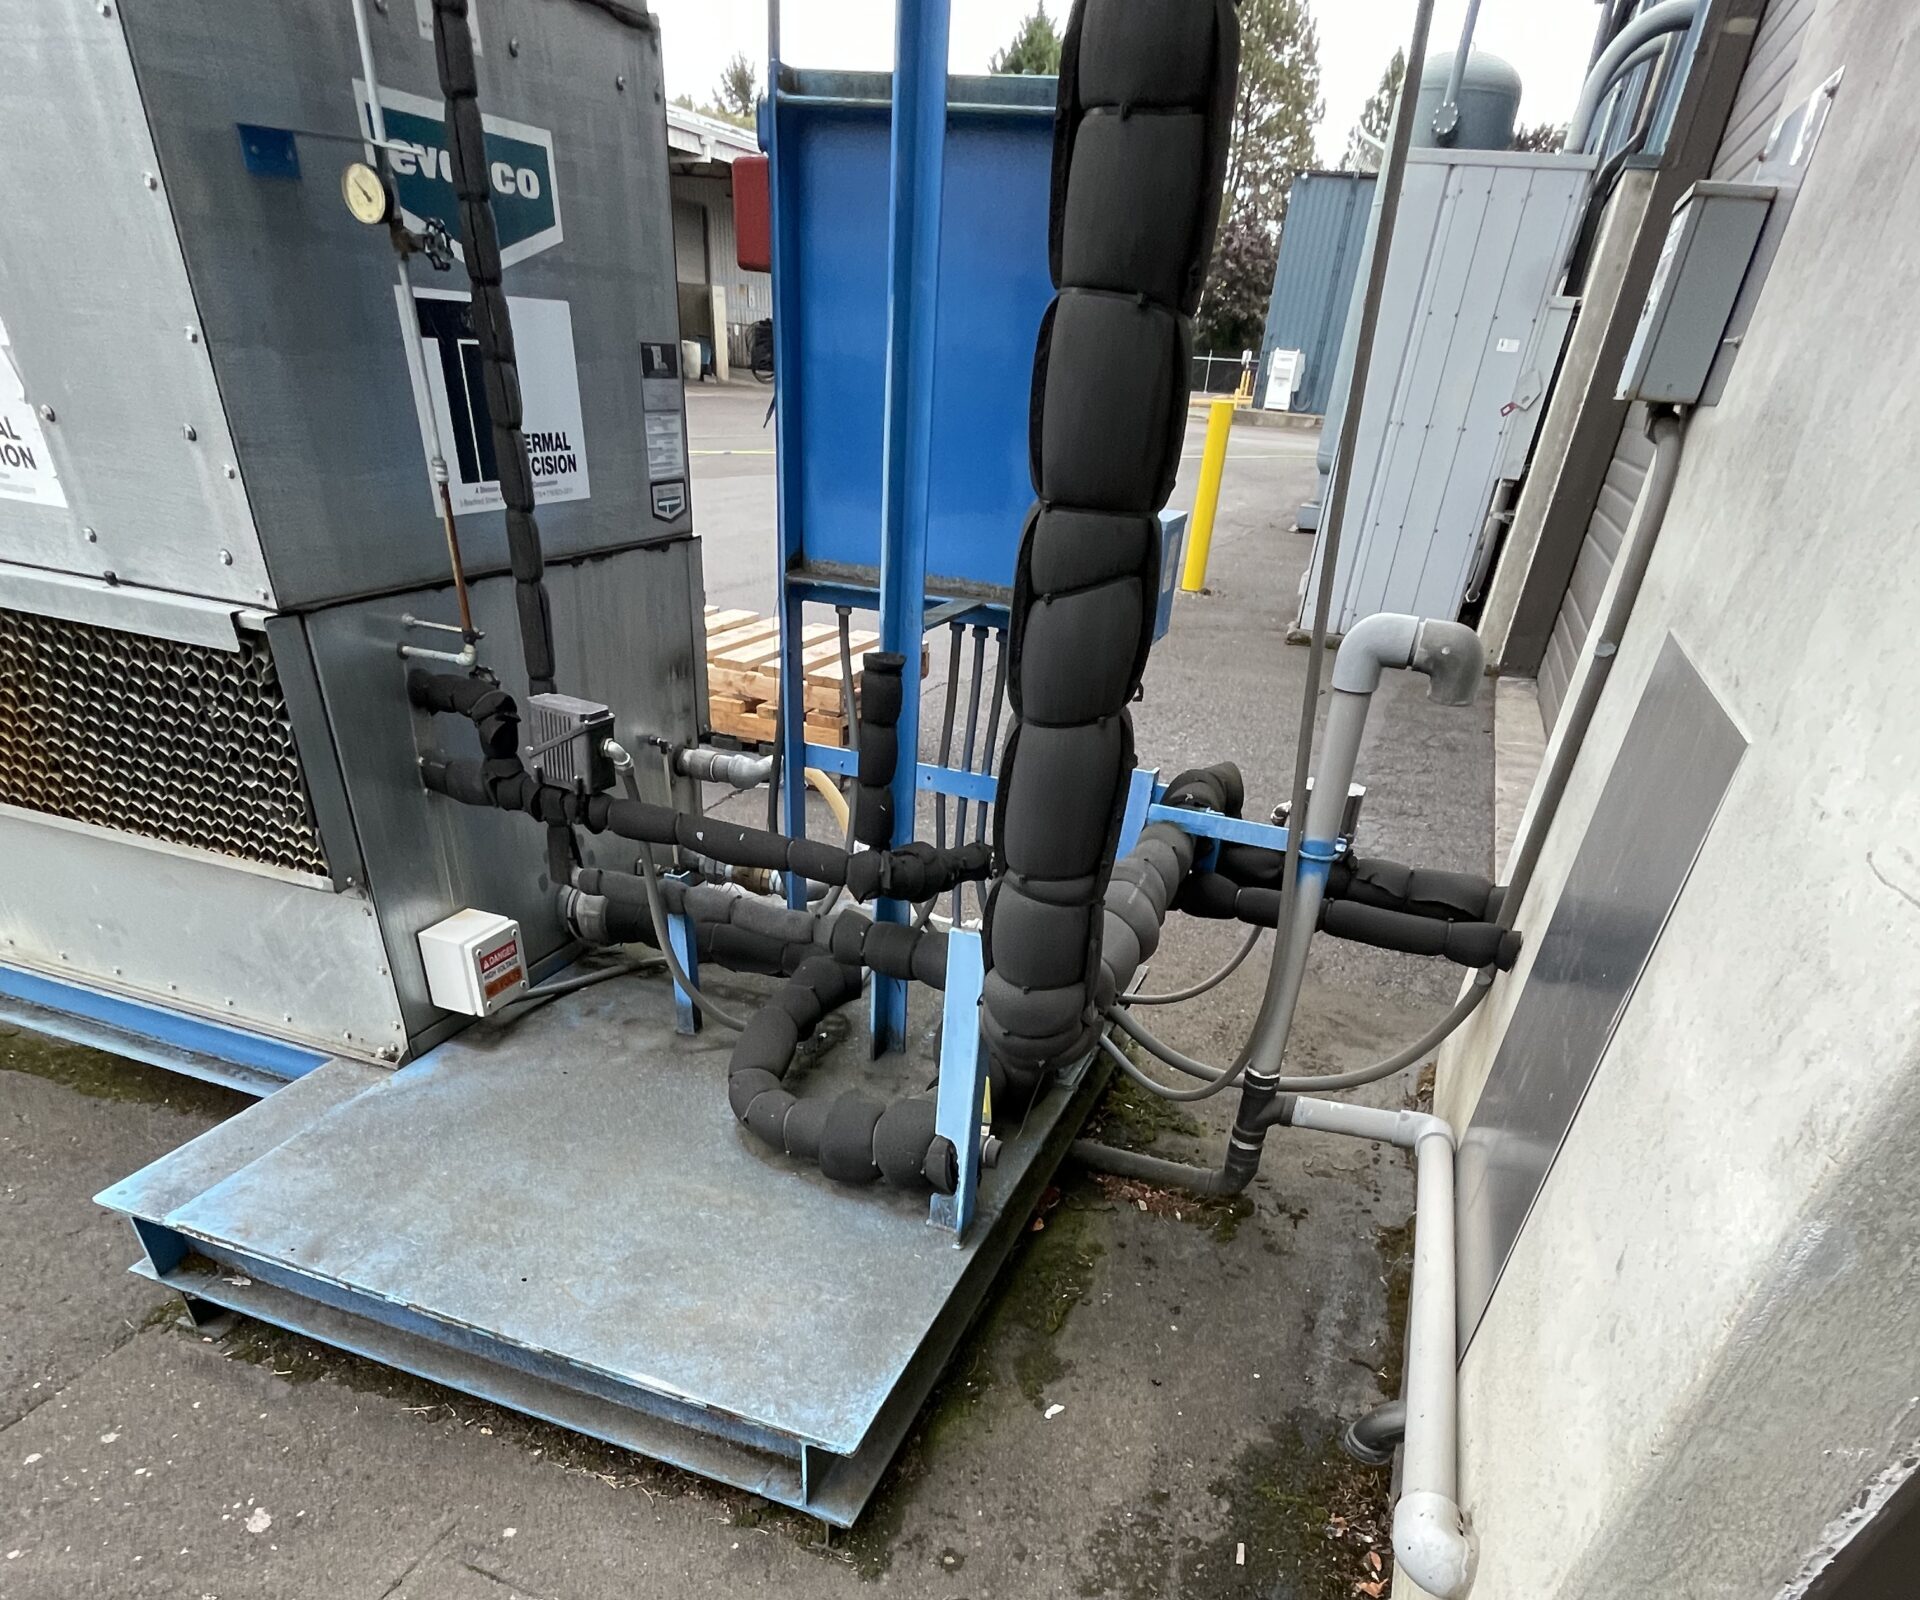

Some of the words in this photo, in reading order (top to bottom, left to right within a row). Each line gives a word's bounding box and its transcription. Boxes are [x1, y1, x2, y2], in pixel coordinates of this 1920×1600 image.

[524, 432, 571, 453] ERMAL
[531, 454, 577, 476] CISION
[488, 943, 516, 966] DANGER
